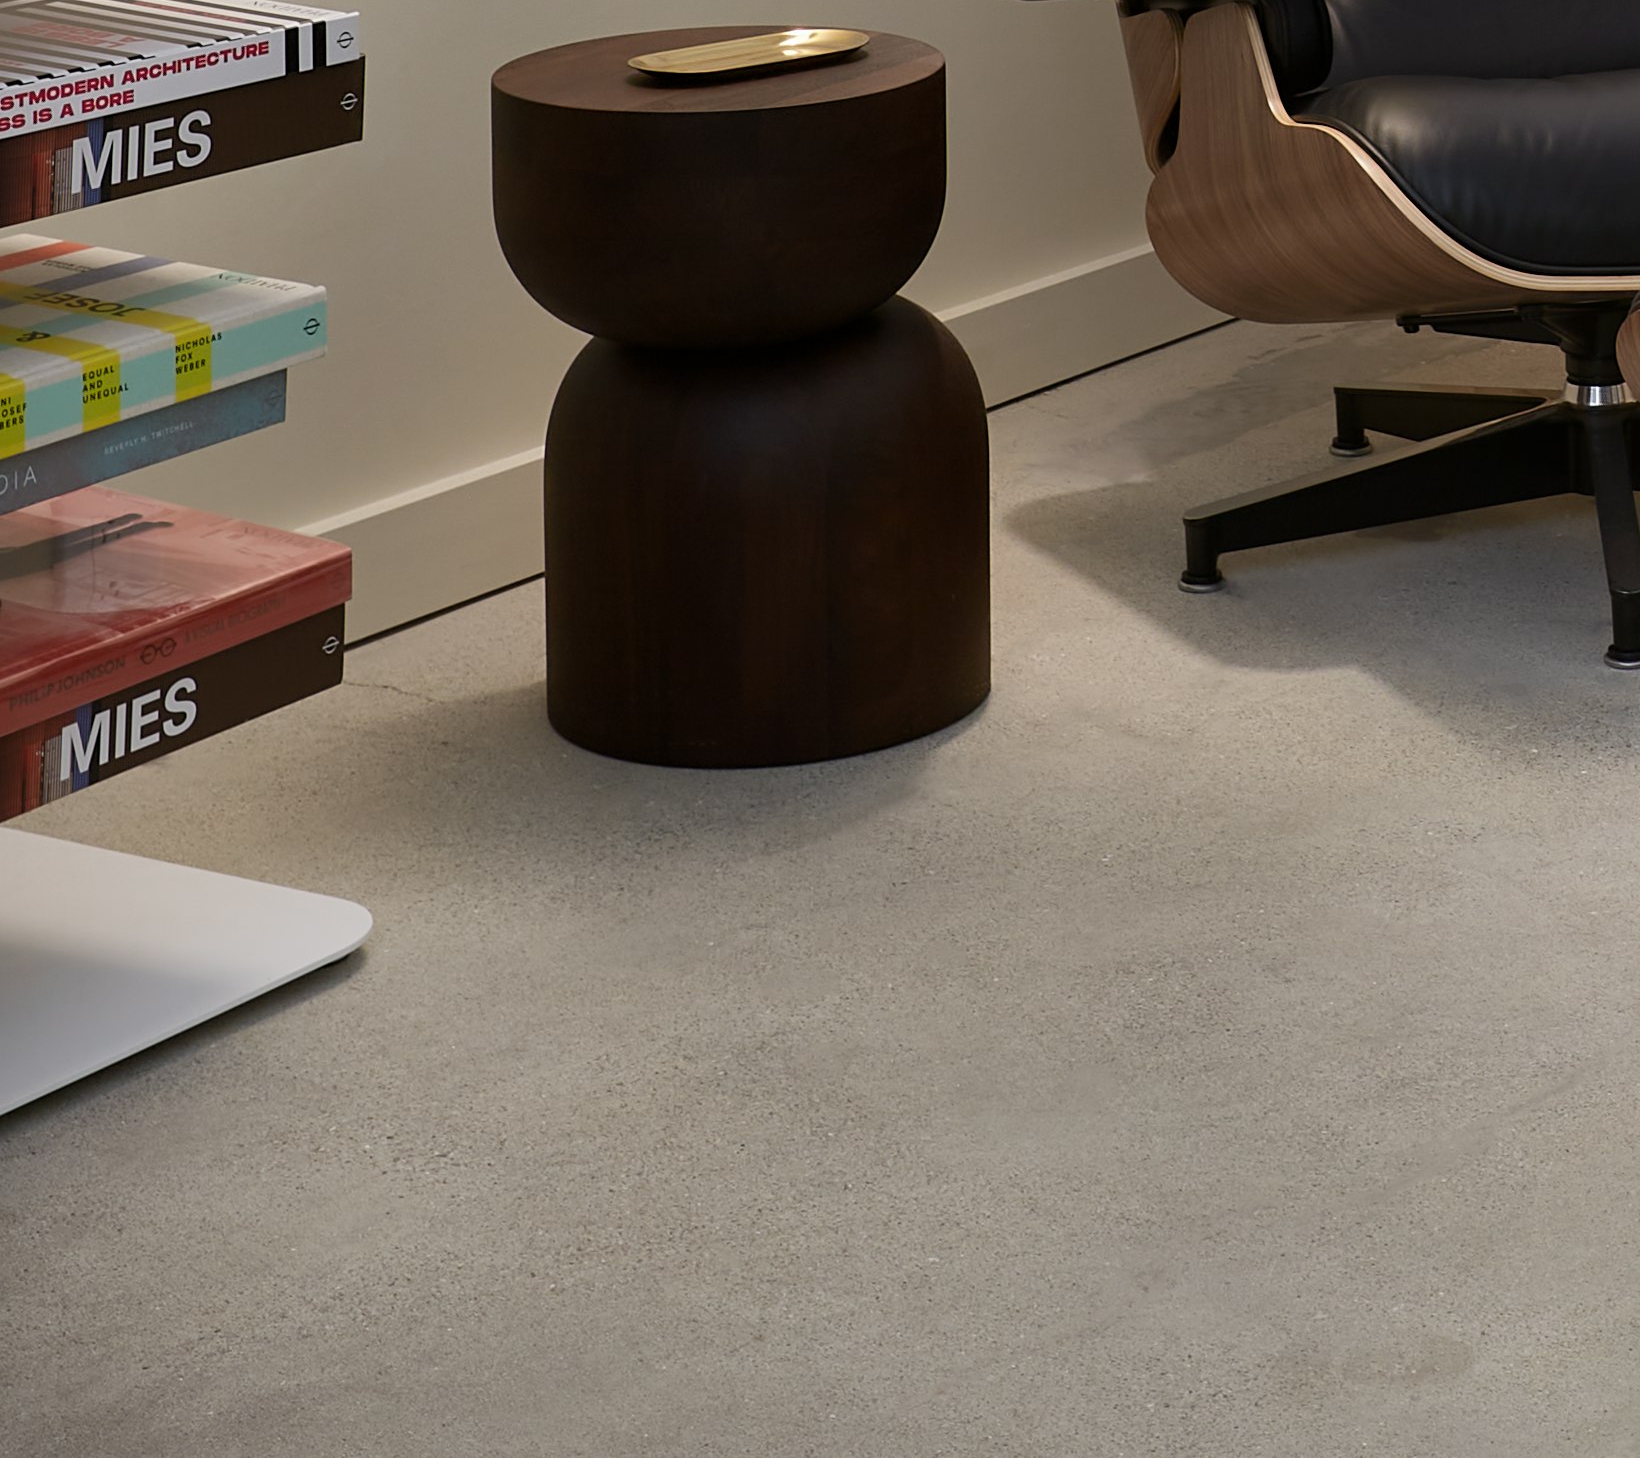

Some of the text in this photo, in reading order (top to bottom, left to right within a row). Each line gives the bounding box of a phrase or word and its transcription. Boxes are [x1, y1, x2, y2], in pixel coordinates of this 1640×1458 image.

[0, 41, 270, 111] STMODERN ARCHITECTURE
[33, 108, 52, 125] IS
[60, 103, 75, 119] A
[81, 89, 135, 114] BORE
[71, 109, 212, 195] MIES
[175, 332, 223, 353] NICHOLAS
[175, 351, 193, 364] FOX
[175, 359, 206, 375] WEBER
[82, 365, 115, 382] EQUAL
[82, 380, 103, 393] AND
[82, 383, 129, 404] UNEQUAL
[9, 656, 126, 712] PHILIP JOHNSON
[60, 677, 198, 781] MIES
